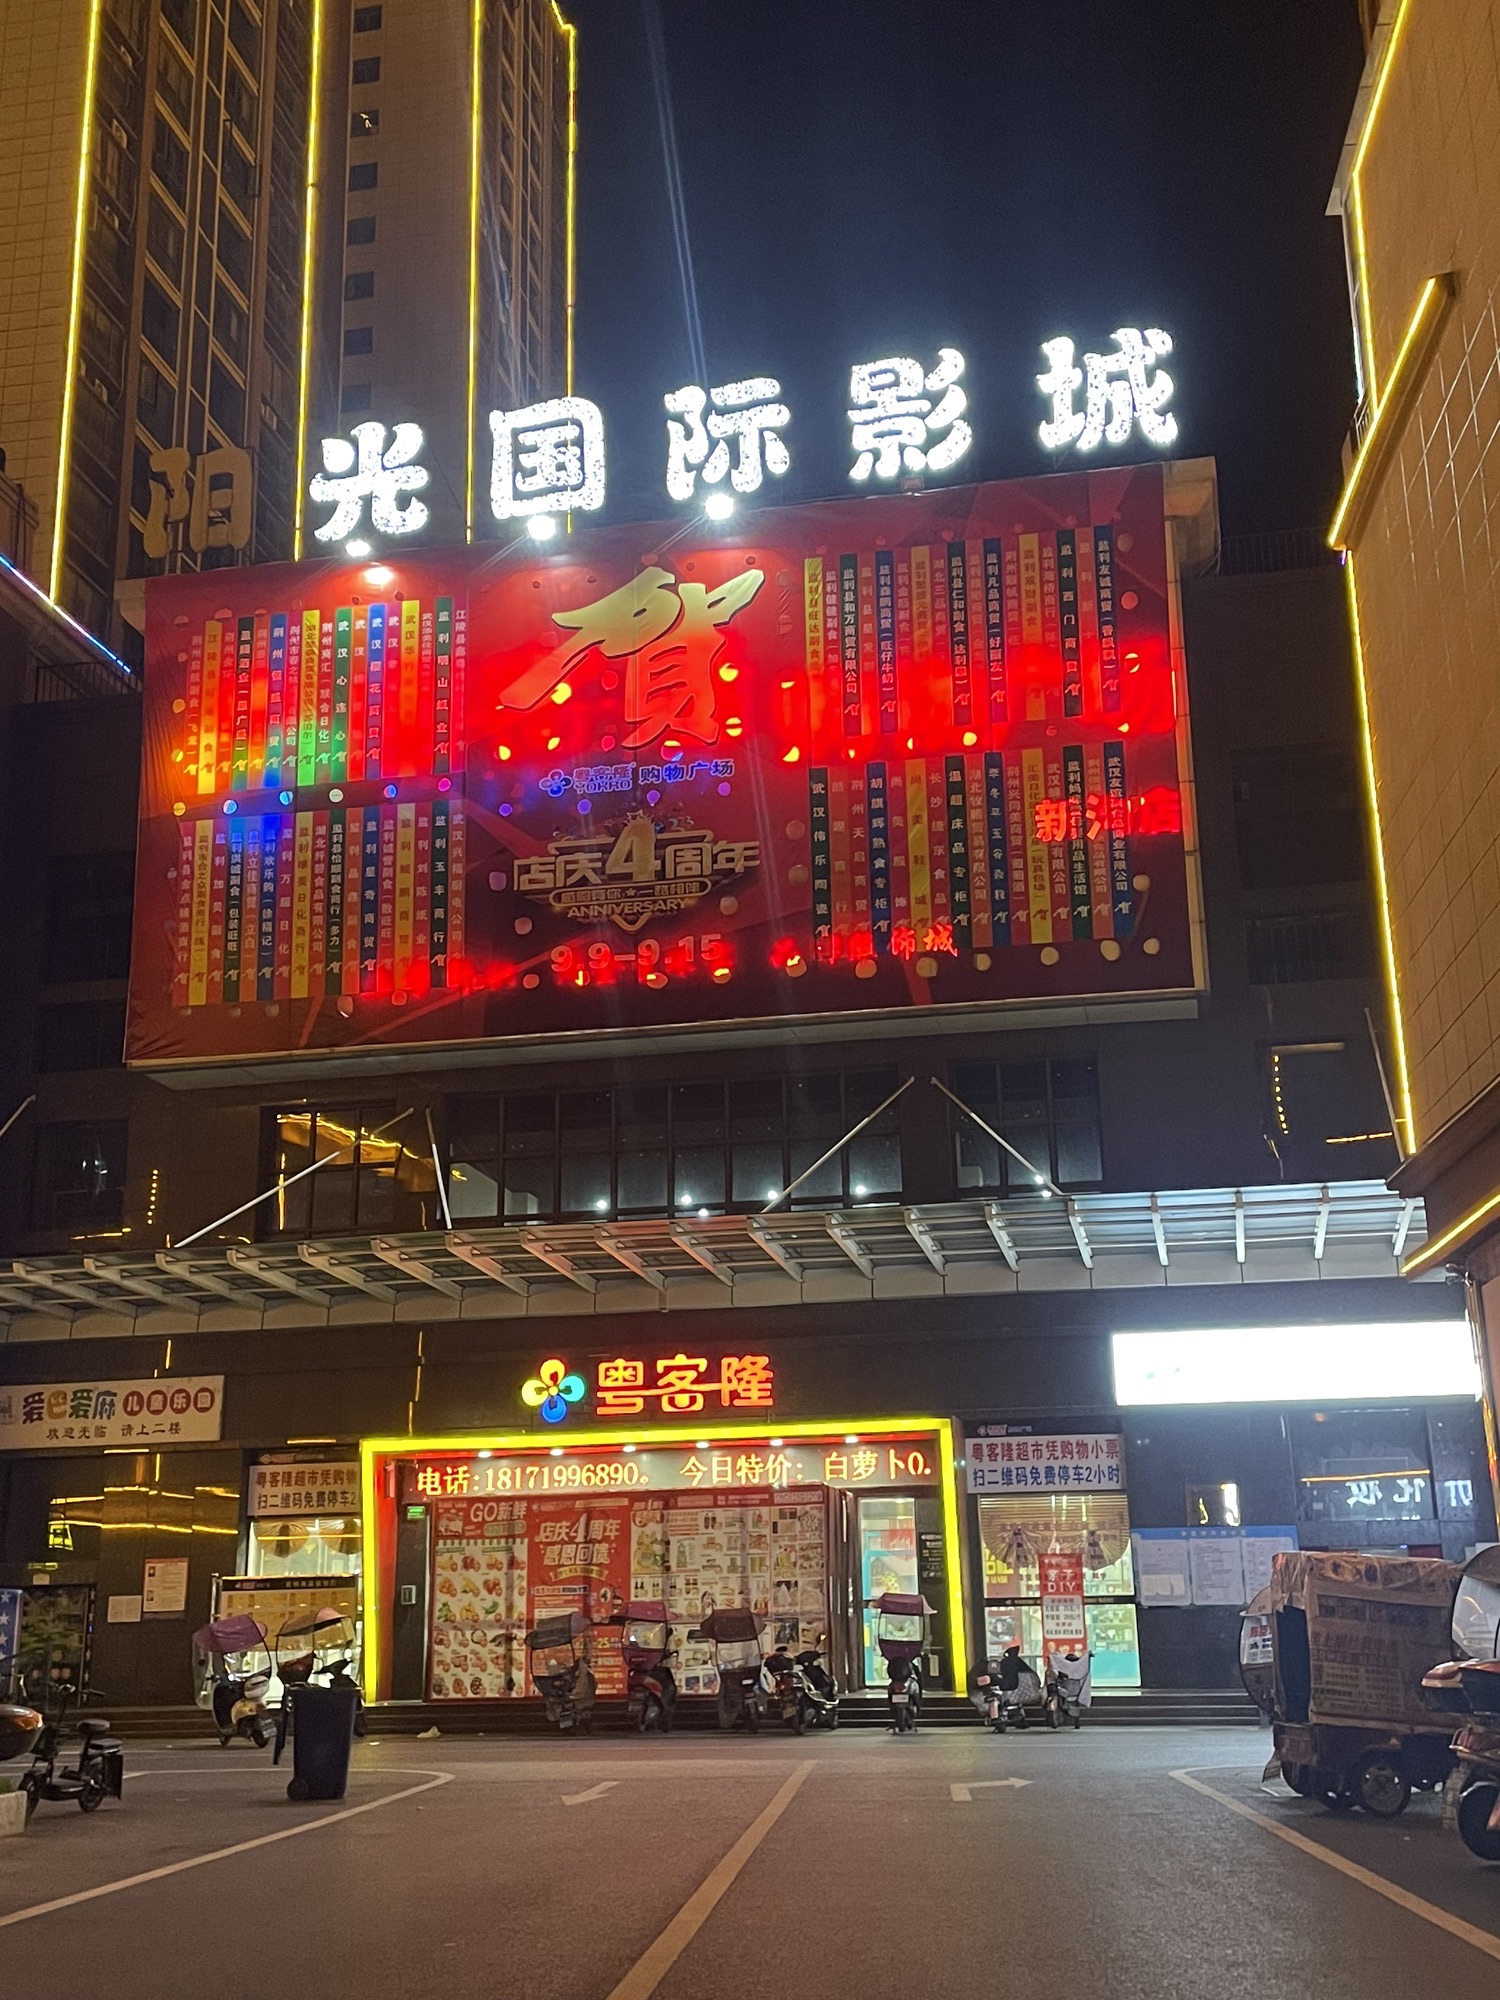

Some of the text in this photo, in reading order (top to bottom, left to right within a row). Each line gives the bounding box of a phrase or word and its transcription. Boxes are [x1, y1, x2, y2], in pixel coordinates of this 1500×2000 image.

[639, 759, 735, 785] 购物广场
[567, 898, 688, 918] ANNIVERSARY
[596, 1354, 774, 1415] 粤客隆
[125, 1388, 214, 1416] 儿童乐园
[46, 1421, 182, 1441] 欢迎光临 请上二楼
[972, 1438, 1120, 1463] 粤客隆超市凭购物小票
[973, 1463, 1121, 1488] 扫二维码免费停车2小时
[534, 1512, 621, 1543] 店庆4周年
[1046, 1581, 1076, 1593] DIY
